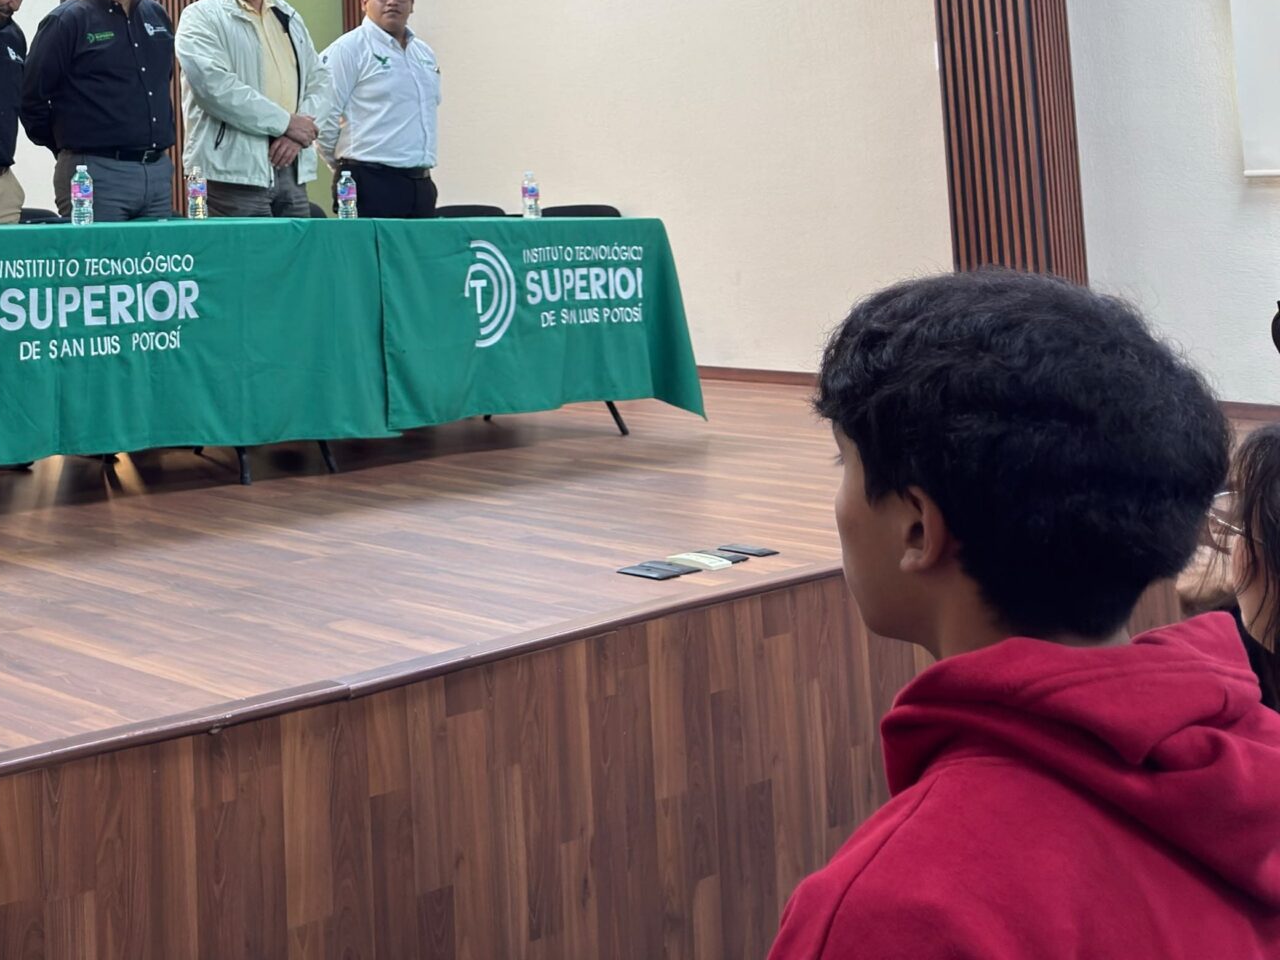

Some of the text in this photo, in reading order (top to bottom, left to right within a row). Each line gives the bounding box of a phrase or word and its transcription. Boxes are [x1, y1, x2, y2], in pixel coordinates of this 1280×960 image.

[84, 251, 194, 277] TECNOLÓGICO
[522, 245, 574, 264] INSTITUTO
[540, 310, 557, 328] DE
[578, 307, 600, 324] LUIS
[602, 302, 643, 323] POTOSÍ
[19, 325, 182, 361] DE SAN LUIS POTOSÍ
